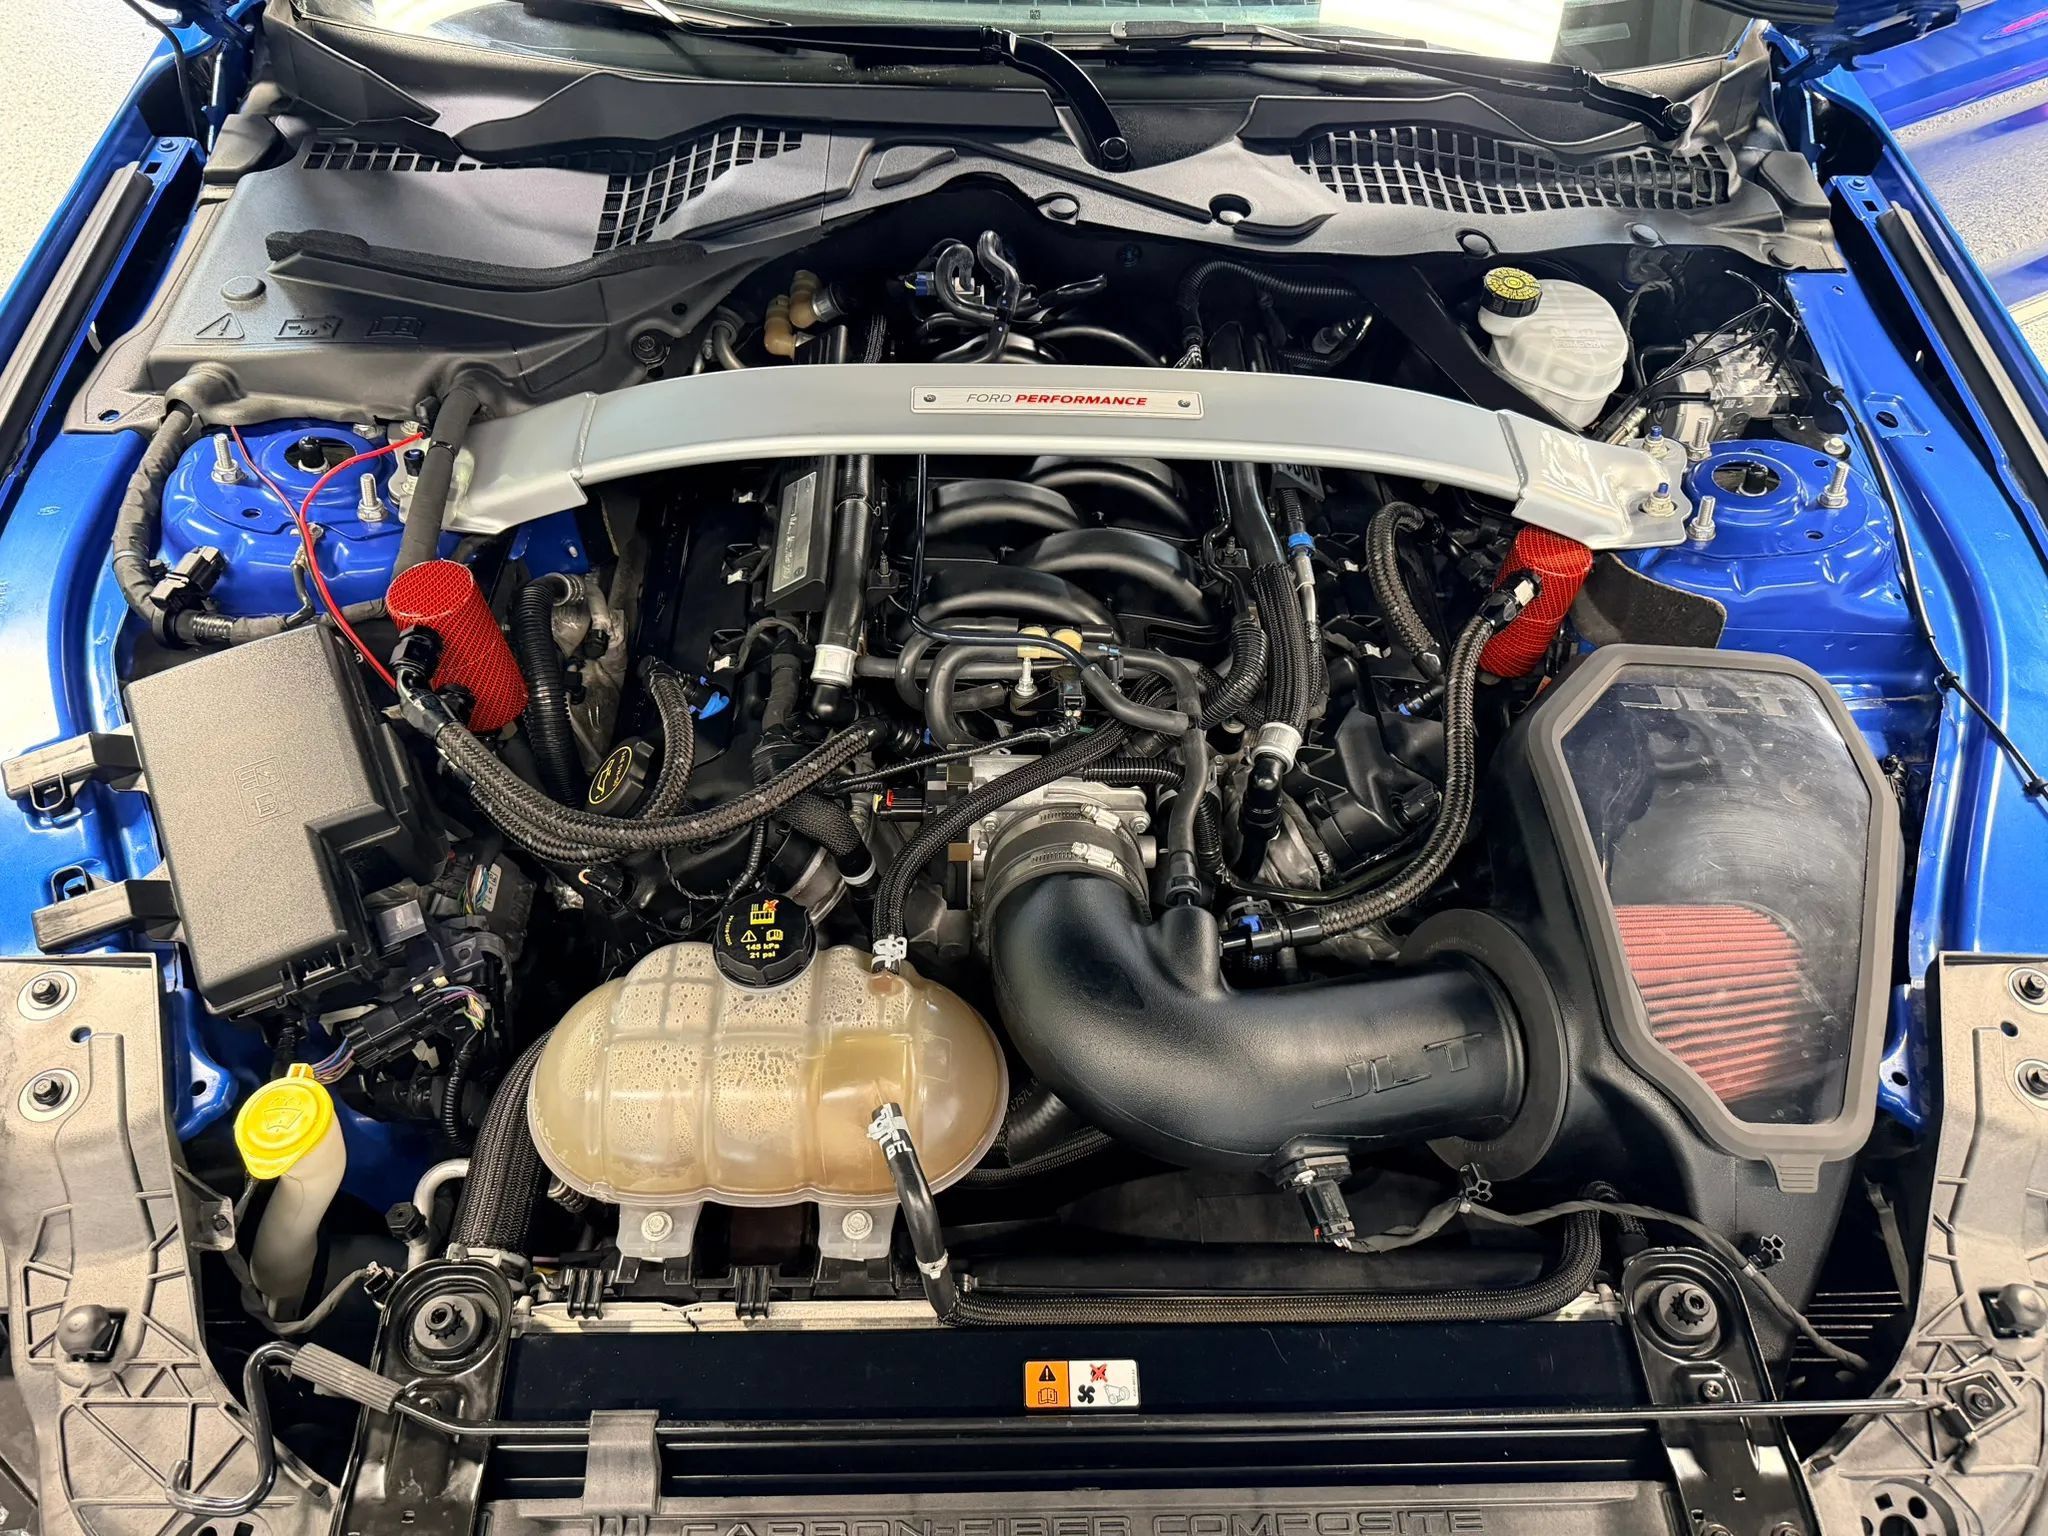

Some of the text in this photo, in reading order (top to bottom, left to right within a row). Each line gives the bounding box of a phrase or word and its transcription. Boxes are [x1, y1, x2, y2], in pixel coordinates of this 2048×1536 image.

[966, 393, 1148, 406] FORD PERFORMANCE
[1619, 684, 1795, 718] JLT
[745, 942, 780, 951] 145 kPa
[749, 950, 776, 959] 21 psi
[1311, 1032, 1483, 1110] JLT
[885, 1139, 913, 1161] BTL
[1152, 1509, 1485, 1536] COMPOSITE
